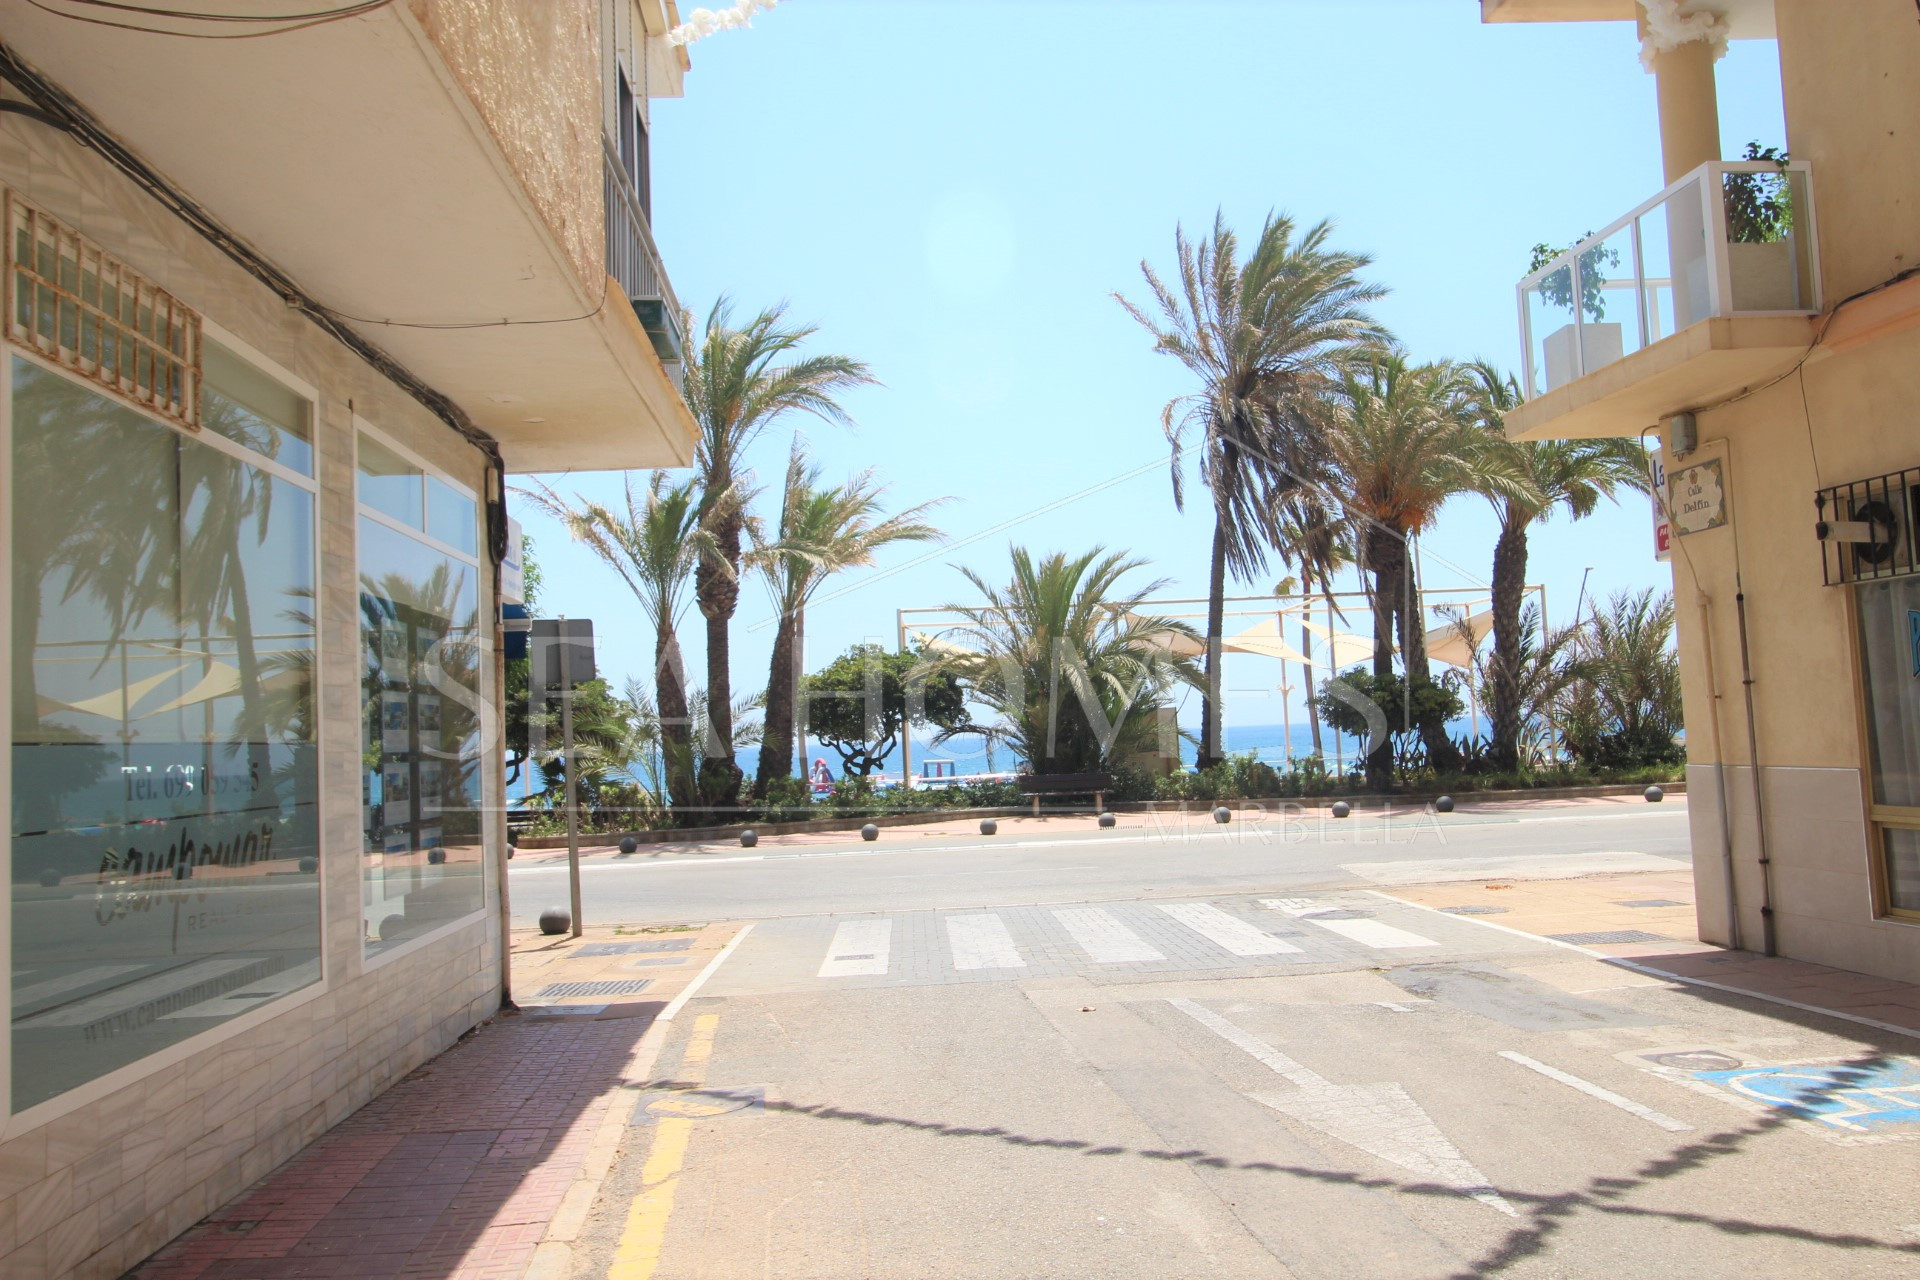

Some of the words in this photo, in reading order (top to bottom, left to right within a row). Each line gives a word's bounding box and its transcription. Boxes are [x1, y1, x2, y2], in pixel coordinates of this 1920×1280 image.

[1688, 485, 1702, 497] Calle
[121, 765, 157, 801] Tel.
[187, 906, 228, 932] REAL
